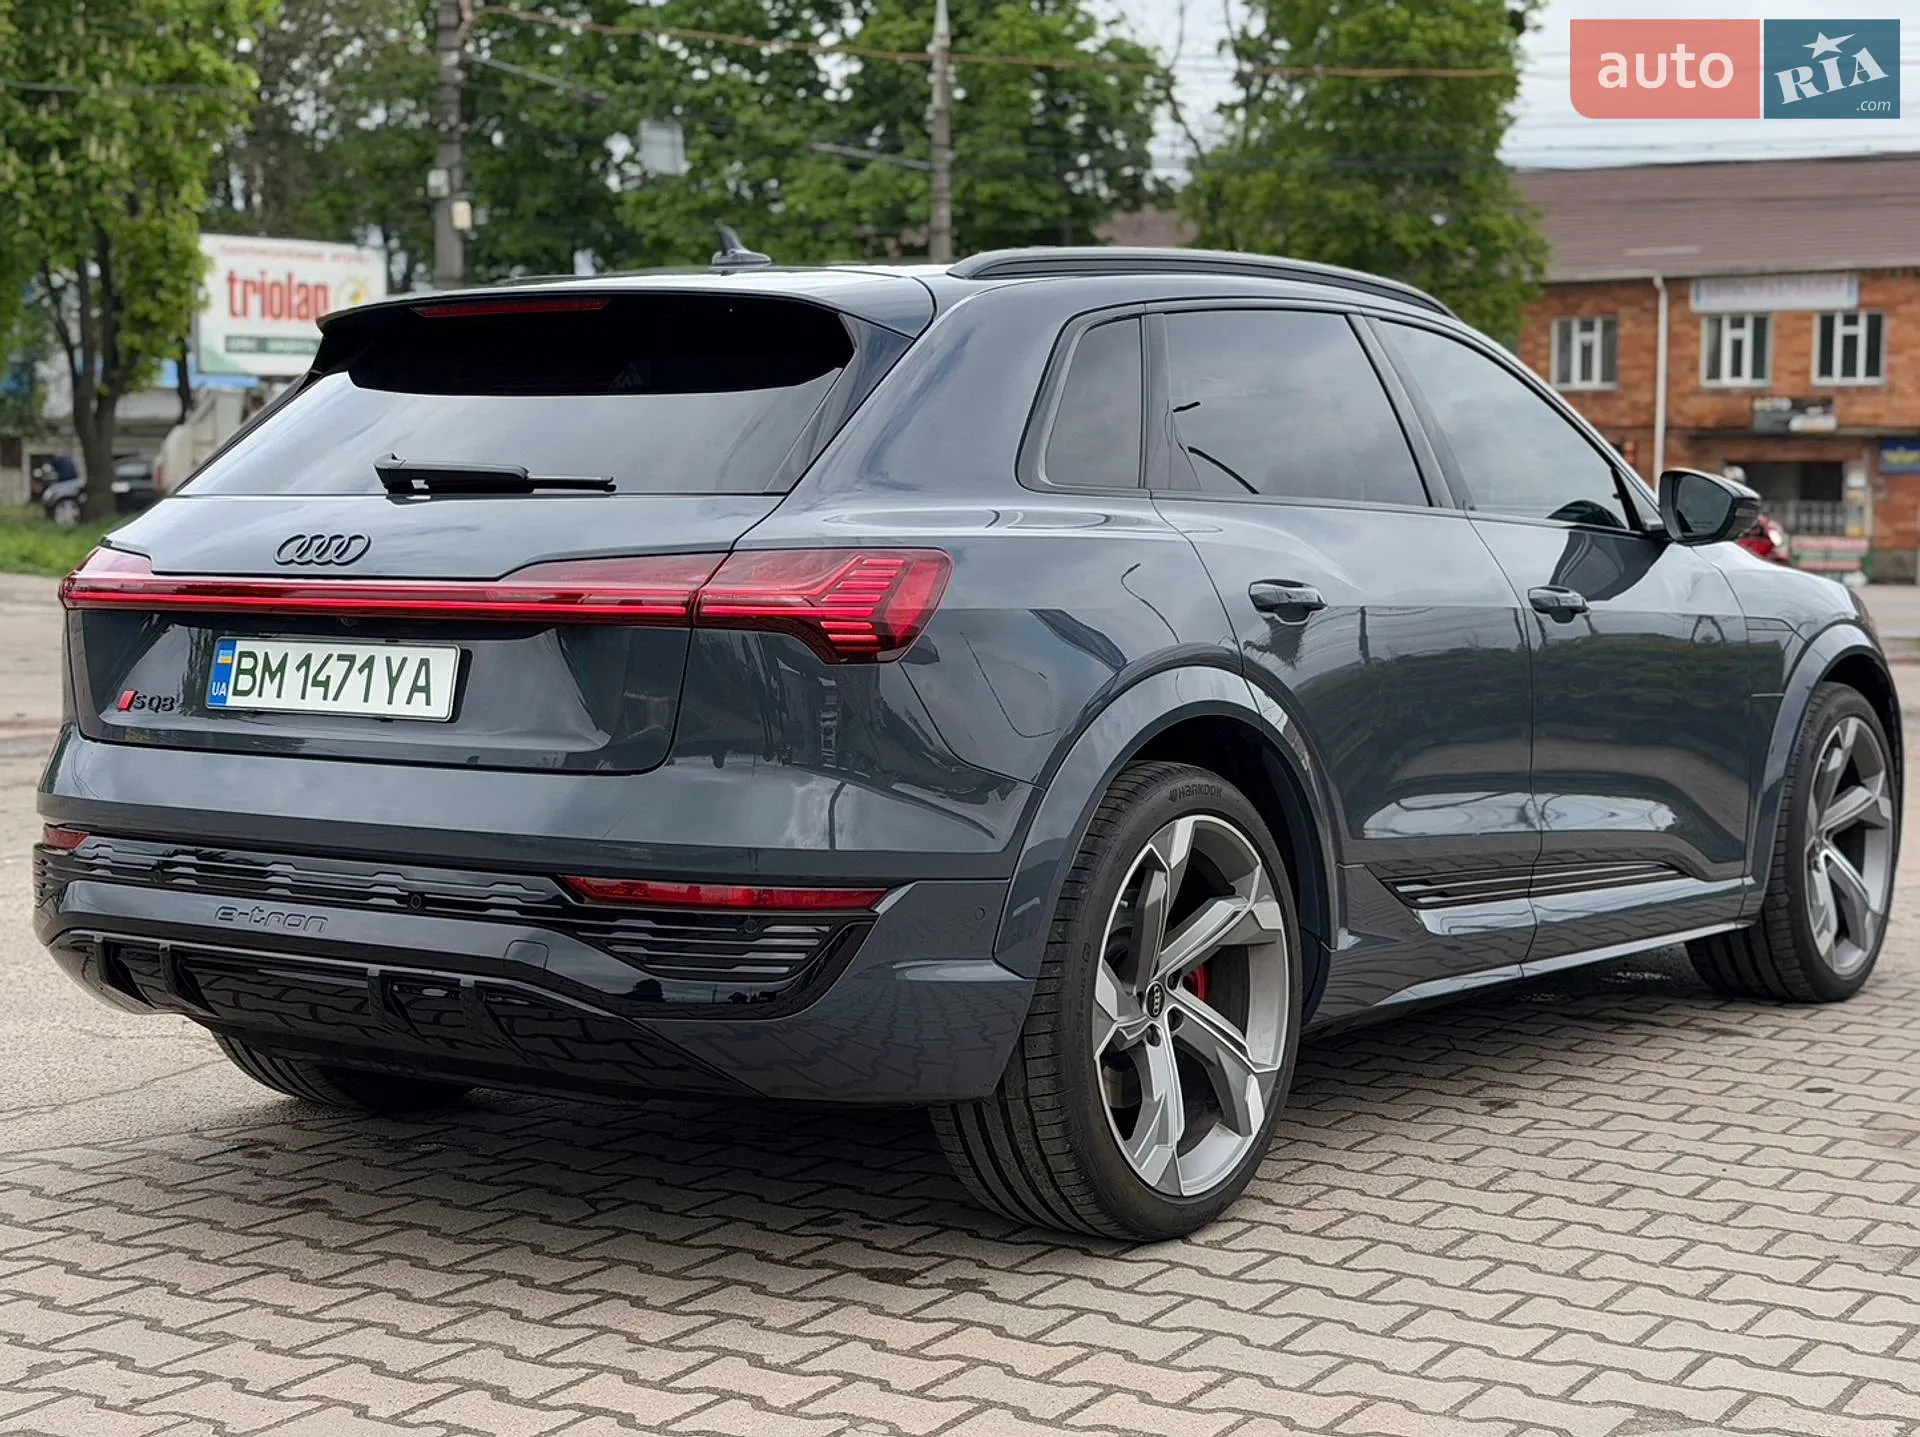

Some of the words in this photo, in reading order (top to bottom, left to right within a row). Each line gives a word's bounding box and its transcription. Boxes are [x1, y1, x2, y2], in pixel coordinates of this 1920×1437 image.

[227, 269, 332, 322] triolan
[211, 681, 227, 697] UA
[214, 905, 329, 933] e-tron
